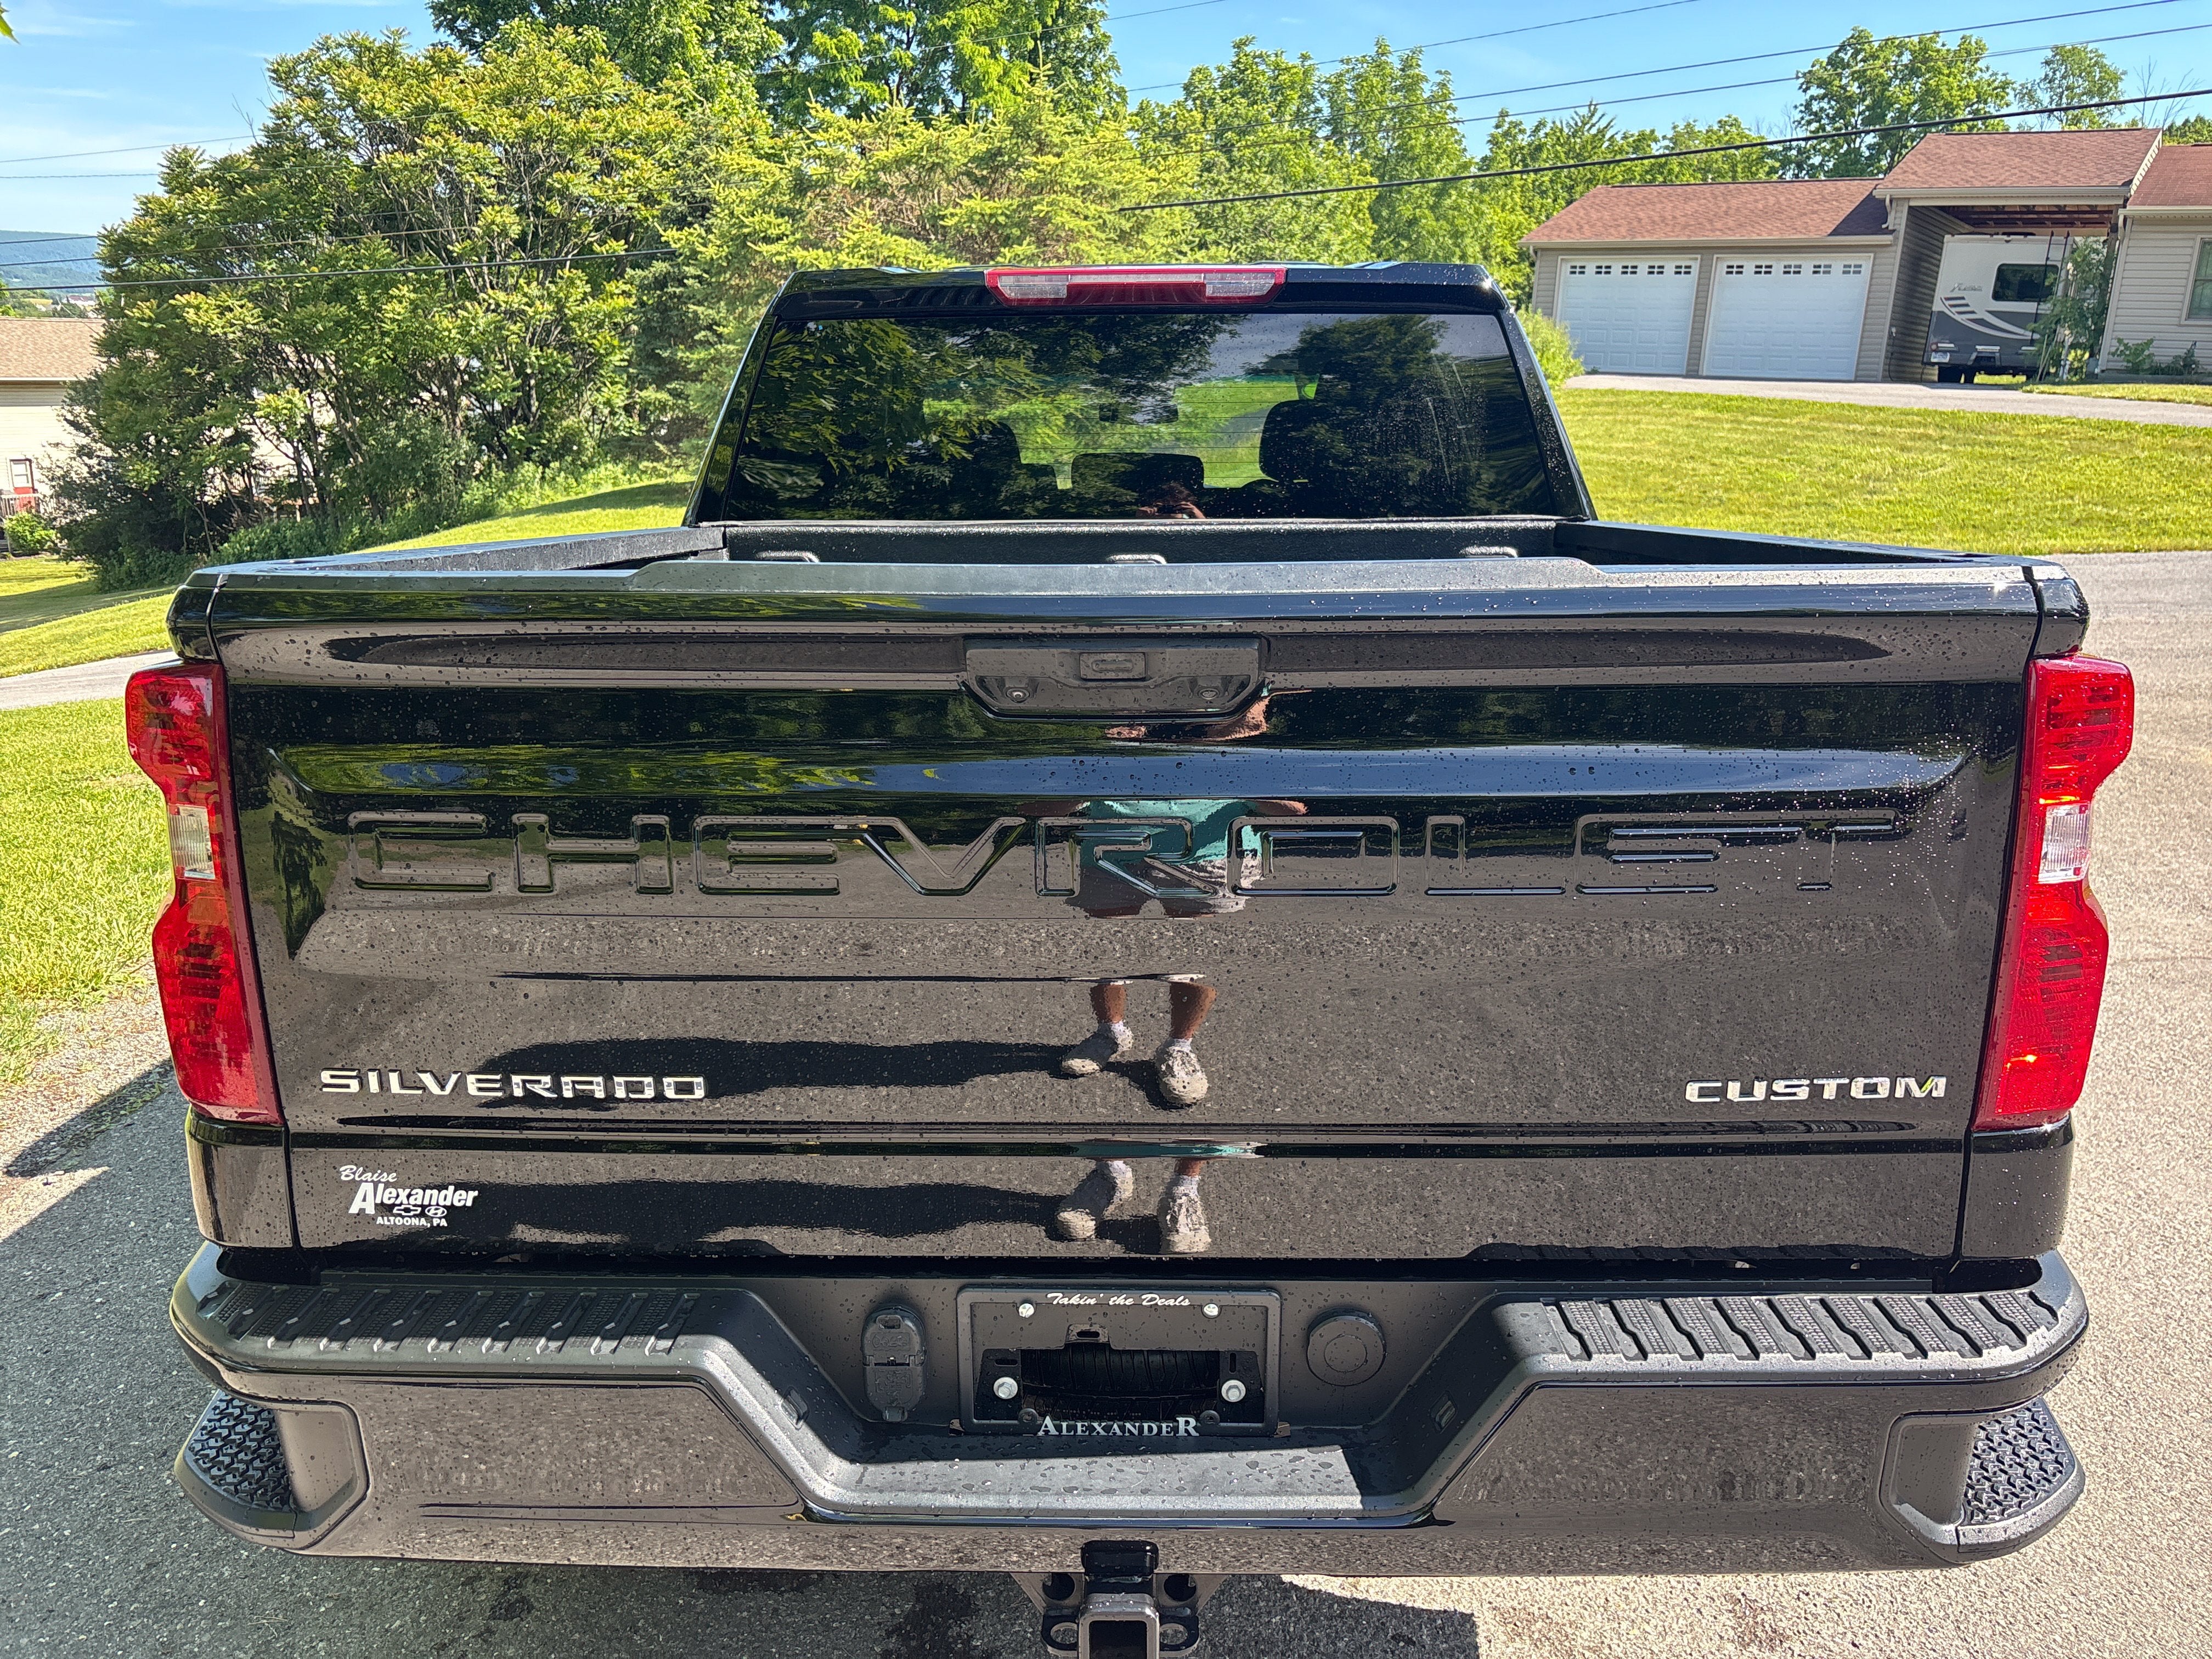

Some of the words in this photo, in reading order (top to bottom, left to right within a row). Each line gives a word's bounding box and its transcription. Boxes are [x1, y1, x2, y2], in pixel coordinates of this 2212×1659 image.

[347, 809, 1901, 898] CHEVROLET
[320, 1068, 707, 1099] SILVERADO
[1685, 1075, 1947, 1103] CUSTOM
[339, 1165, 398, 1182] Blaise
[348, 1182, 479, 1215] Alexander
[376, 1216, 430, 1228] ALTOONA,
[433, 1218, 448, 1227] PA
[1046, 1292, 1104, 1305] Takin'
[1108, 1293, 1135, 1305] the
[1141, 1293, 1191, 1306] Deals
[1037, 1415, 1200, 1437] ALEXANDER
